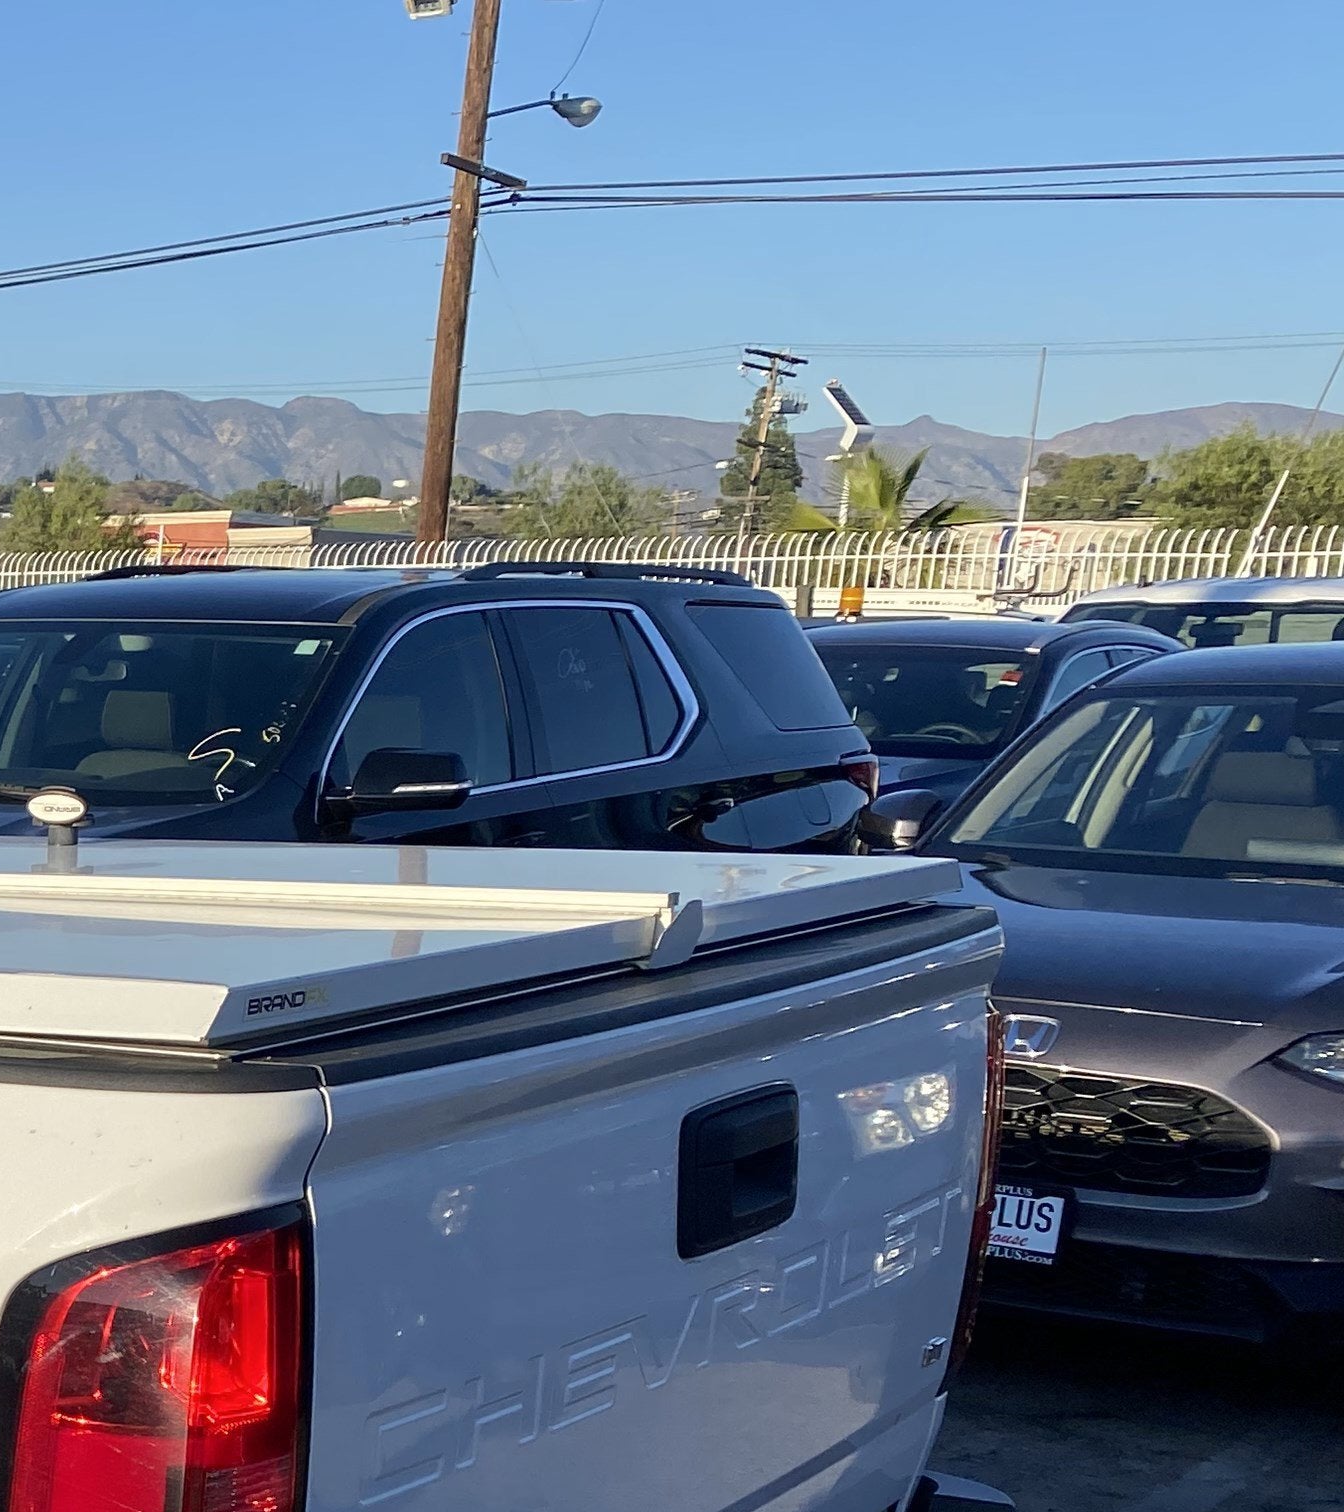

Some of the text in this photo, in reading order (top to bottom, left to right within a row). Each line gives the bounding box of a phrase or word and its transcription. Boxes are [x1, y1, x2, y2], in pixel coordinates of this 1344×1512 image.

[995, 1184, 1033, 1197] RPLUS
[996, 1197, 1055, 1233] LUS
[985, 1246, 1053, 1265] PLUS.COM
[359, 1184, 962, 1507] CHEVROLET
